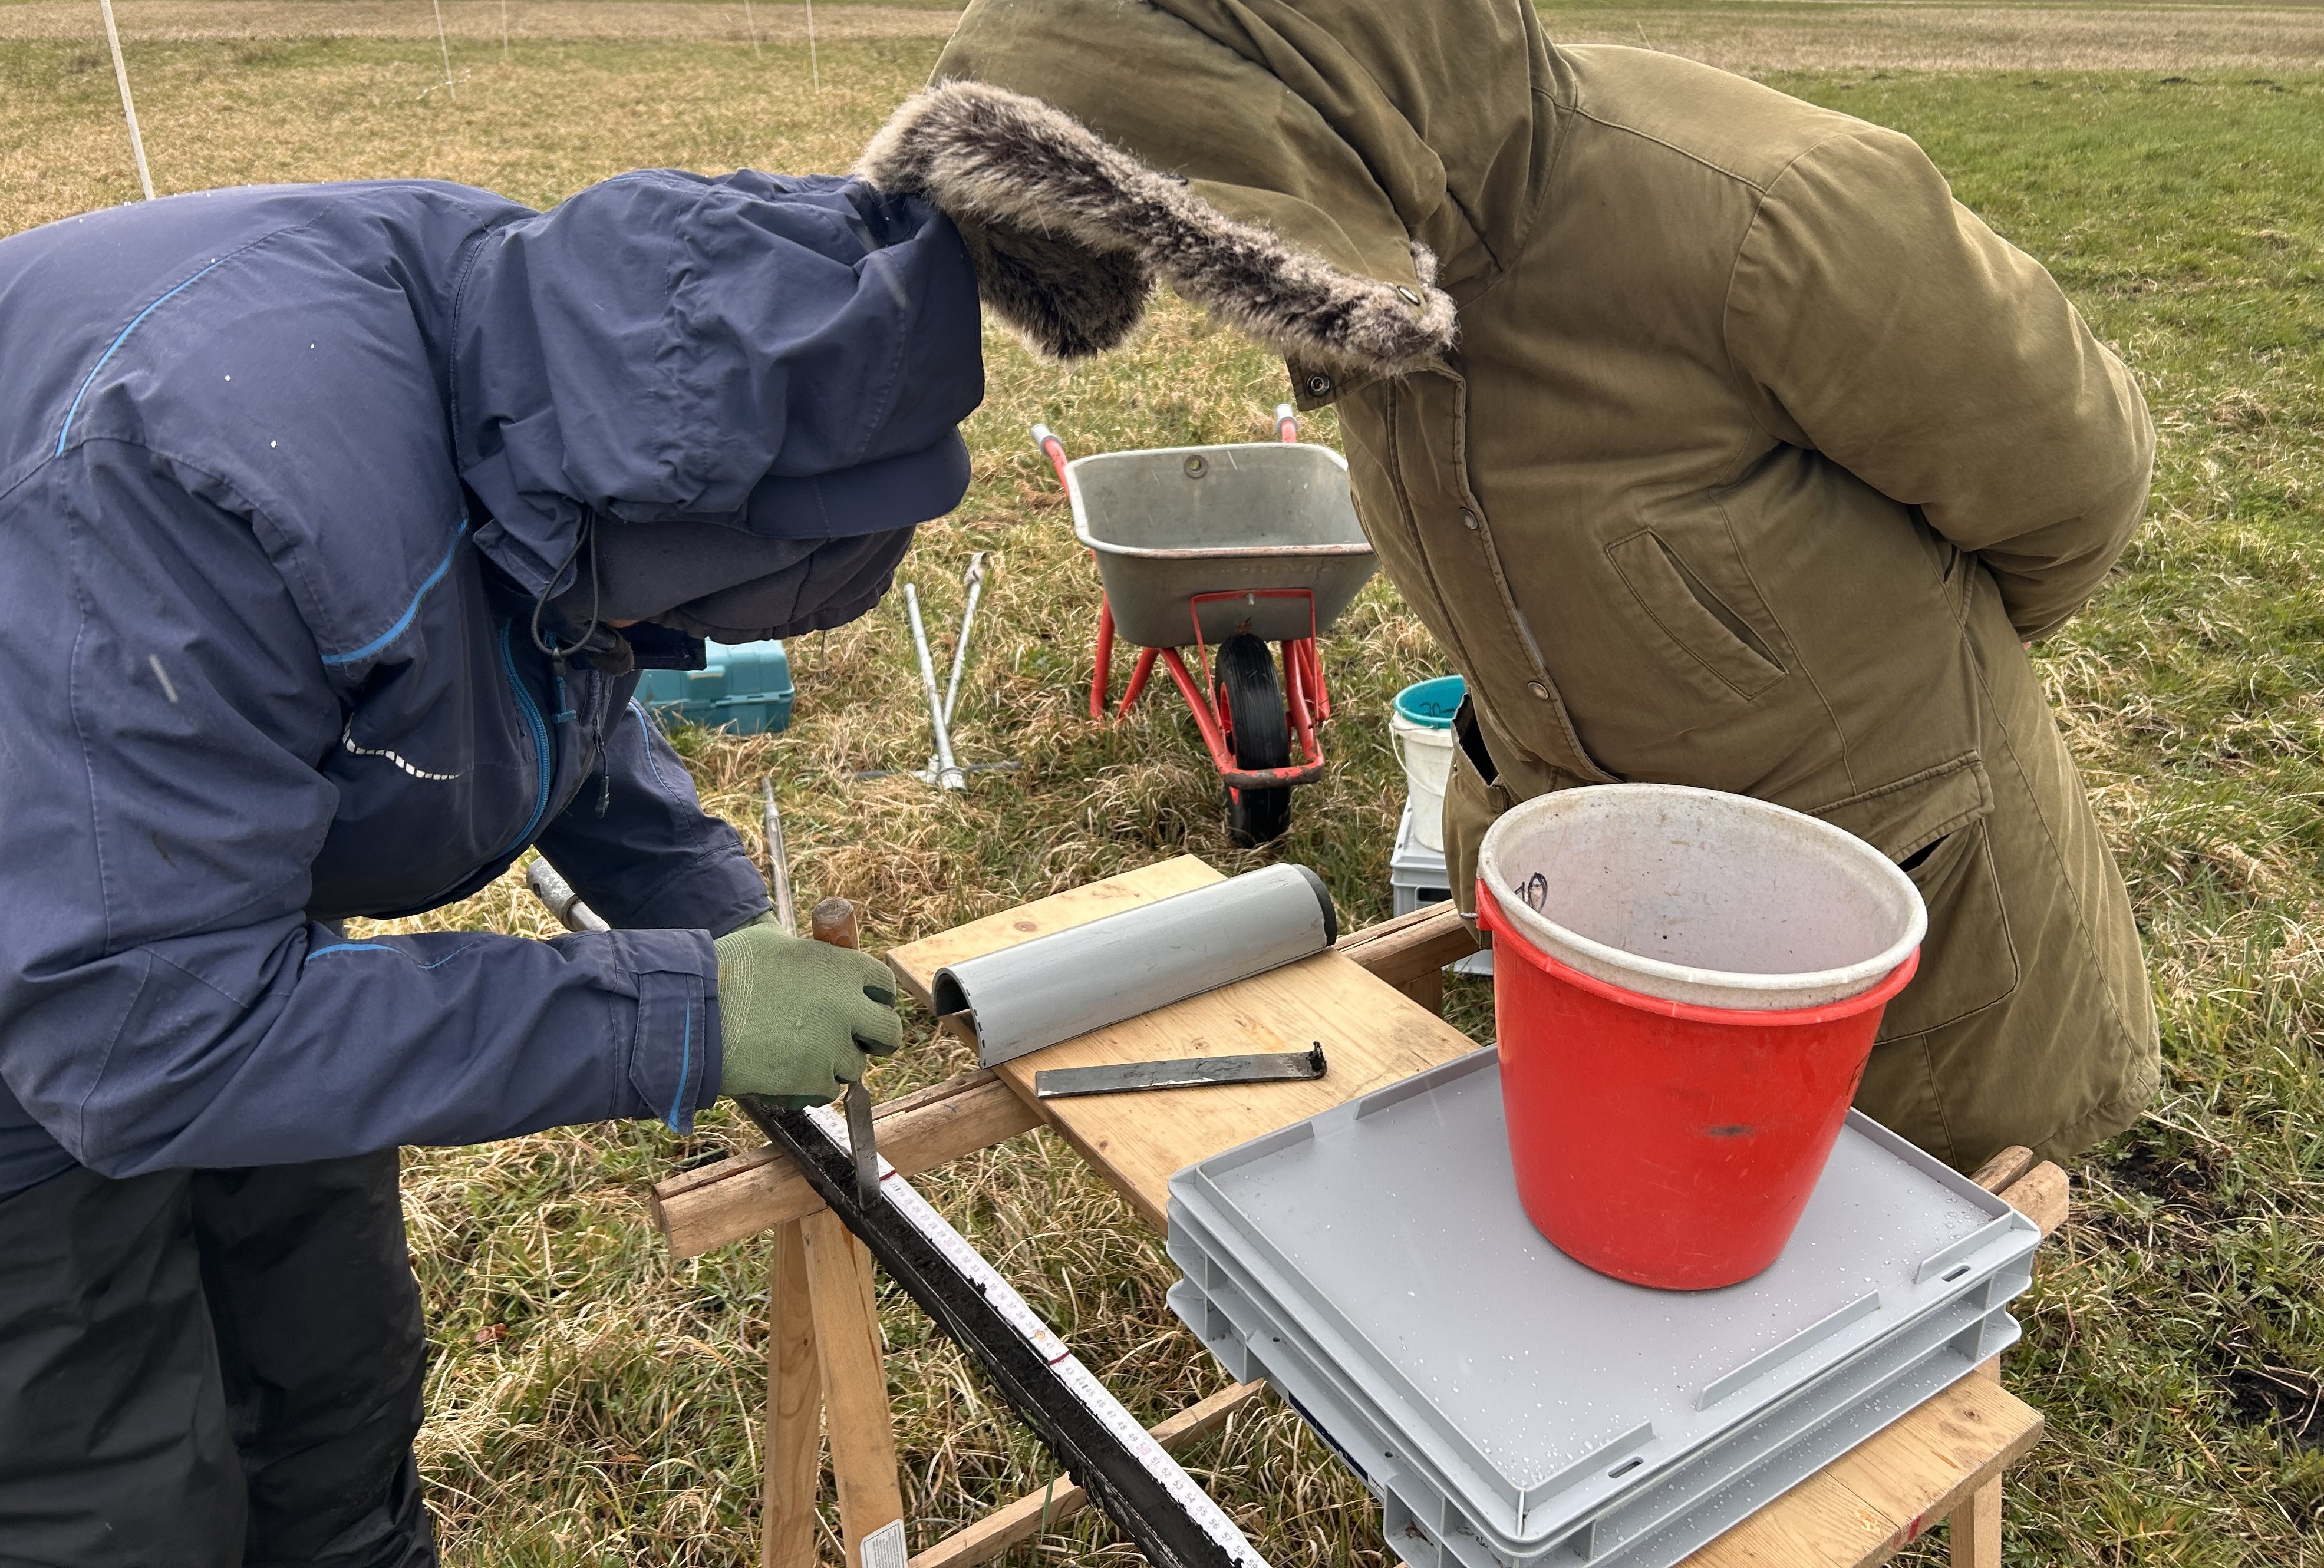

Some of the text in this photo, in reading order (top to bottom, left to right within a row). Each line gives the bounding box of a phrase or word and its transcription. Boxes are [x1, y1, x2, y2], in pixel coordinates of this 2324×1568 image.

[1026, 1321, 1035, 1329] 39
[1086, 1388, 1095, 1397] 45
[1097, 1399, 1106, 1408] 46
[1118, 1422, 1128, 1430] 48
[1129, 1433, 1138, 1442] 49
[1136, 1442, 1151, 1455] 50
[1161, 1468, 1172, 1477] 52
[1173, 1480, 1184, 1490] 53
[1185, 1493, 1195, 1503] 54
[1197, 1506, 1208, 1516] 55
[1209, 1519, 1220, 1529] 56
[1222, 1532, 1232, 1541] 57
[1234, 1545, 1245, 1556] 58
[1247, 1559, 1258, 1568] 59
